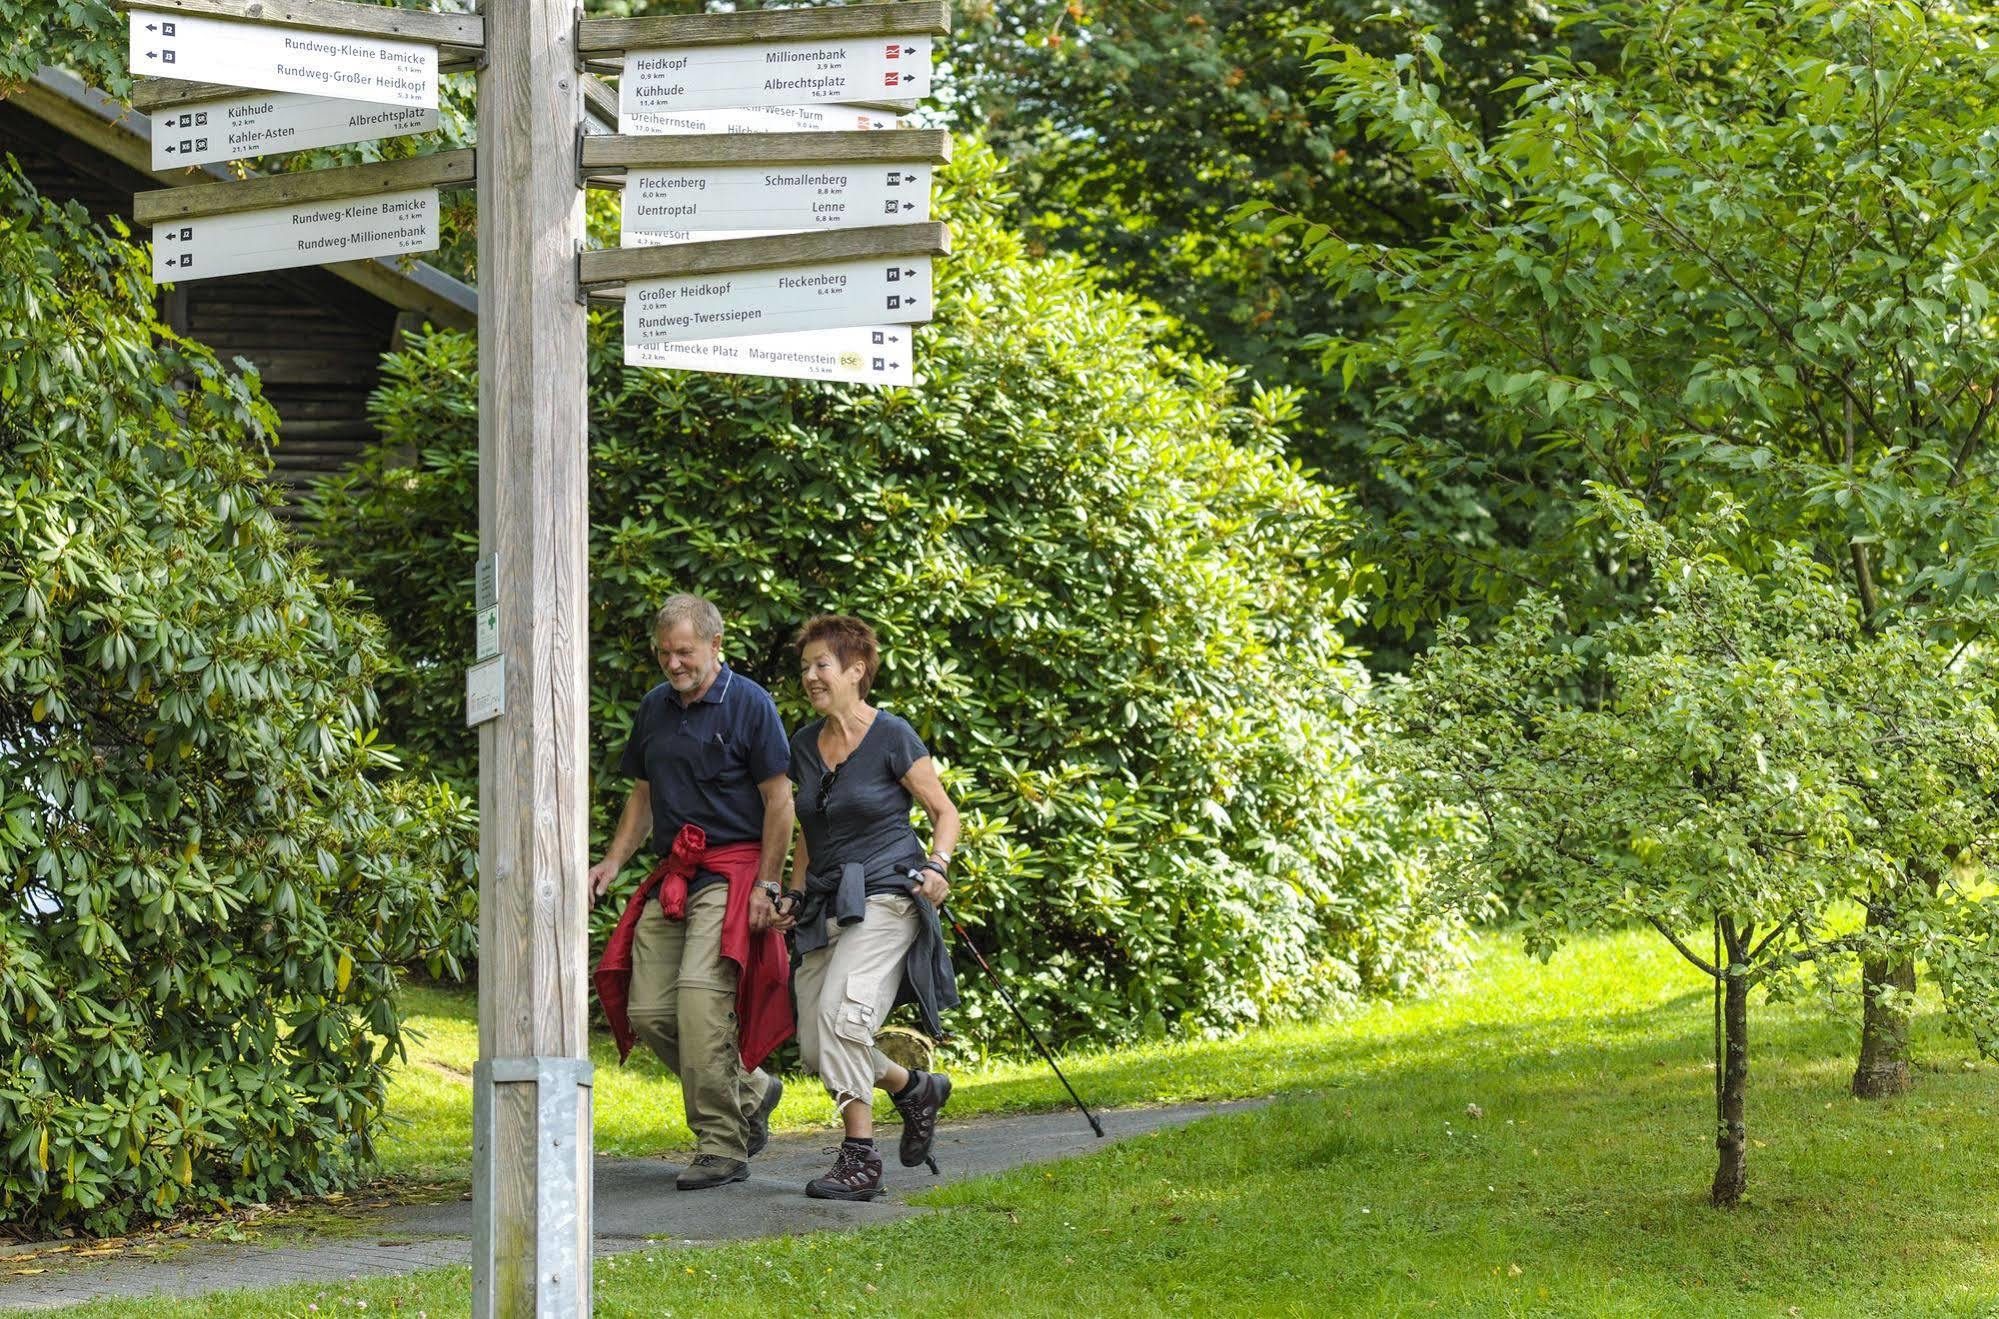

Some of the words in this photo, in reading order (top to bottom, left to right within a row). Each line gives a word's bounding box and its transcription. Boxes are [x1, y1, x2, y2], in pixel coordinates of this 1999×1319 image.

[284, 37, 376, 58] Rundweg-Kleine
[380, 49, 426, 65] Bamicke
[637, 57, 688, 71] Heidkopf
[766, 48, 847, 63] Millionenbank
[410, 66, 422, 74] km
[830, 62, 842, 70] km
[277, 64, 372, 84] Rundweg-Großer
[376, 77, 426, 93] Heidkopf
[653, 72, 666, 80] km
[636, 84, 685, 97] Kühhude
[764, 76, 846, 91] Albrechtsplatz
[410, 93, 422, 101] km
[829, 89, 841, 97] km
[228, 102, 274, 119] Kühhude
[349, 107, 426, 127] Albrechtsplatz
[631, 112, 706, 131] Dreiherrnstein
[244, 118, 256, 126] km
[410, 120, 422, 128] km
[651, 126, 663, 134] km
[228, 126, 295, 144] Kahler-Asten
[248, 143, 260, 151] km
[639, 178, 706, 190] Fleckenberg
[765, 173, 848, 188] Schmallenberg
[830, 187, 843, 195] km
[292, 206, 378, 224] Rundweg-Kleine
[382, 198, 426, 214] Bamicke
[637, 203, 697, 218] Uentroptal
[812, 201, 846, 213] Lenne
[411, 212, 423, 220] km
[828, 214, 841, 222] km
[297, 225, 426, 251] Rundweg-Millionenbank
[411, 238, 423, 247] km
[639, 288, 677, 301] Großer
[681, 281, 731, 298] Heidkopf
[778, 274, 847, 288] Fleckenberg
[830, 286, 843, 294] km
[656, 302, 668, 310] km
[639, 308, 763, 328] Rundweg-Twerssiepen
[655, 329, 668, 338] km
[664, 341, 709, 355] Ermecke
[712, 345, 740, 358] Platz
[654, 353, 666, 361] km
[749, 348, 837, 366] Margaretenstein
